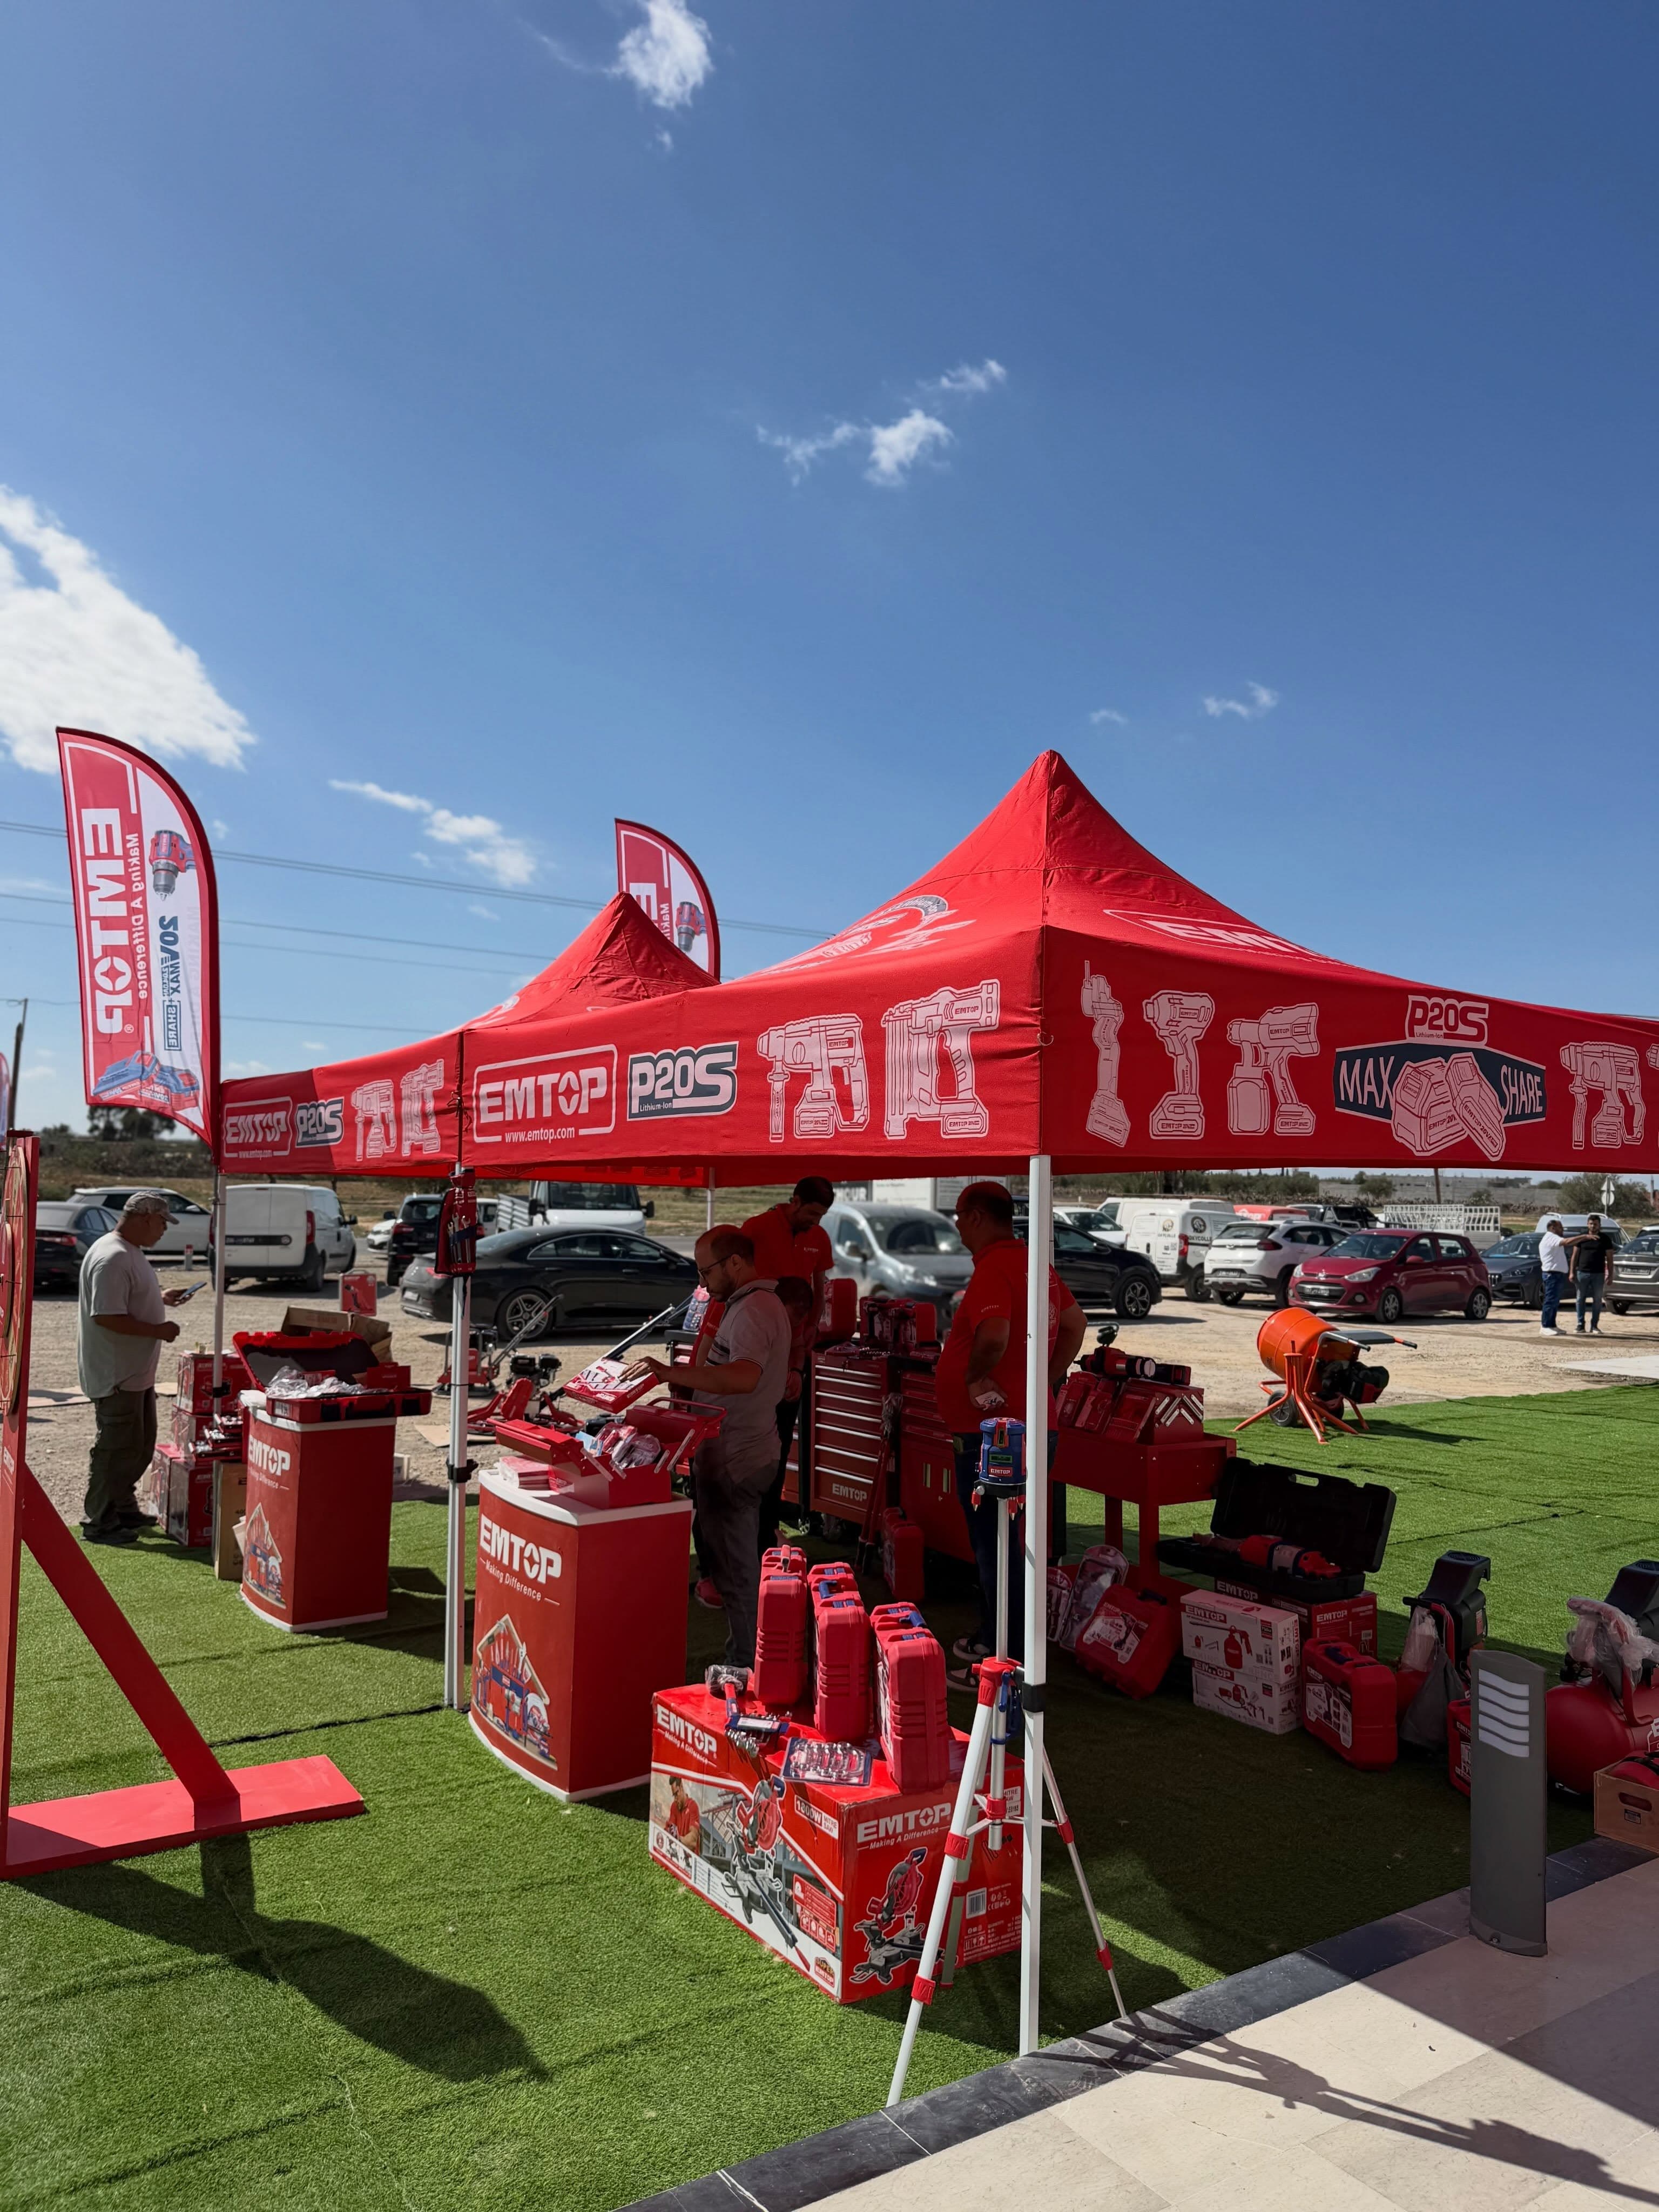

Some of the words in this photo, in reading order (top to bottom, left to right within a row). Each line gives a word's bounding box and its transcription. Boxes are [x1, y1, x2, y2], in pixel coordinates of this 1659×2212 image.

[1409, 1001, 1487, 1041] P20S
[480, 1067, 608, 1123] EMTOP
[631, 1051, 734, 1114] P20S
[1340, 1055, 1395, 1109] MAX
[1500, 1064, 1543, 1115] SHARE
[298, 1101, 343, 1142] P20S
[639, 1101, 672, 1112] Lithium-Ion
[226, 1111, 287, 1144] EMTOP
[505, 1126, 575, 1143] www.emtop.com
[249, 1434, 290, 1476] EMTOP
[832, 1482, 867, 1501] EMTOP
[480, 1513, 562, 1584] EMTOP
[485, 1561, 503, 1583] Making
[504, 1574, 542, 1601] Difference
[1217, 1580, 1258, 1600] EMTOP
[1185, 1606, 1225, 1622] EMTOP
[1316, 1609, 1347, 1622] EMTOP
[656, 1704, 717, 1756] EMTOP
[665, 1730, 680, 1746] Making
[685, 1743, 708, 1765] Difference
[797, 1799, 822, 1824] 1800W
[857, 1802, 951, 1843] EMTOP
[869, 1838, 895, 1849] Making
[896, 1833, 902, 1843] A
[903, 1827, 939, 1841] Difference
